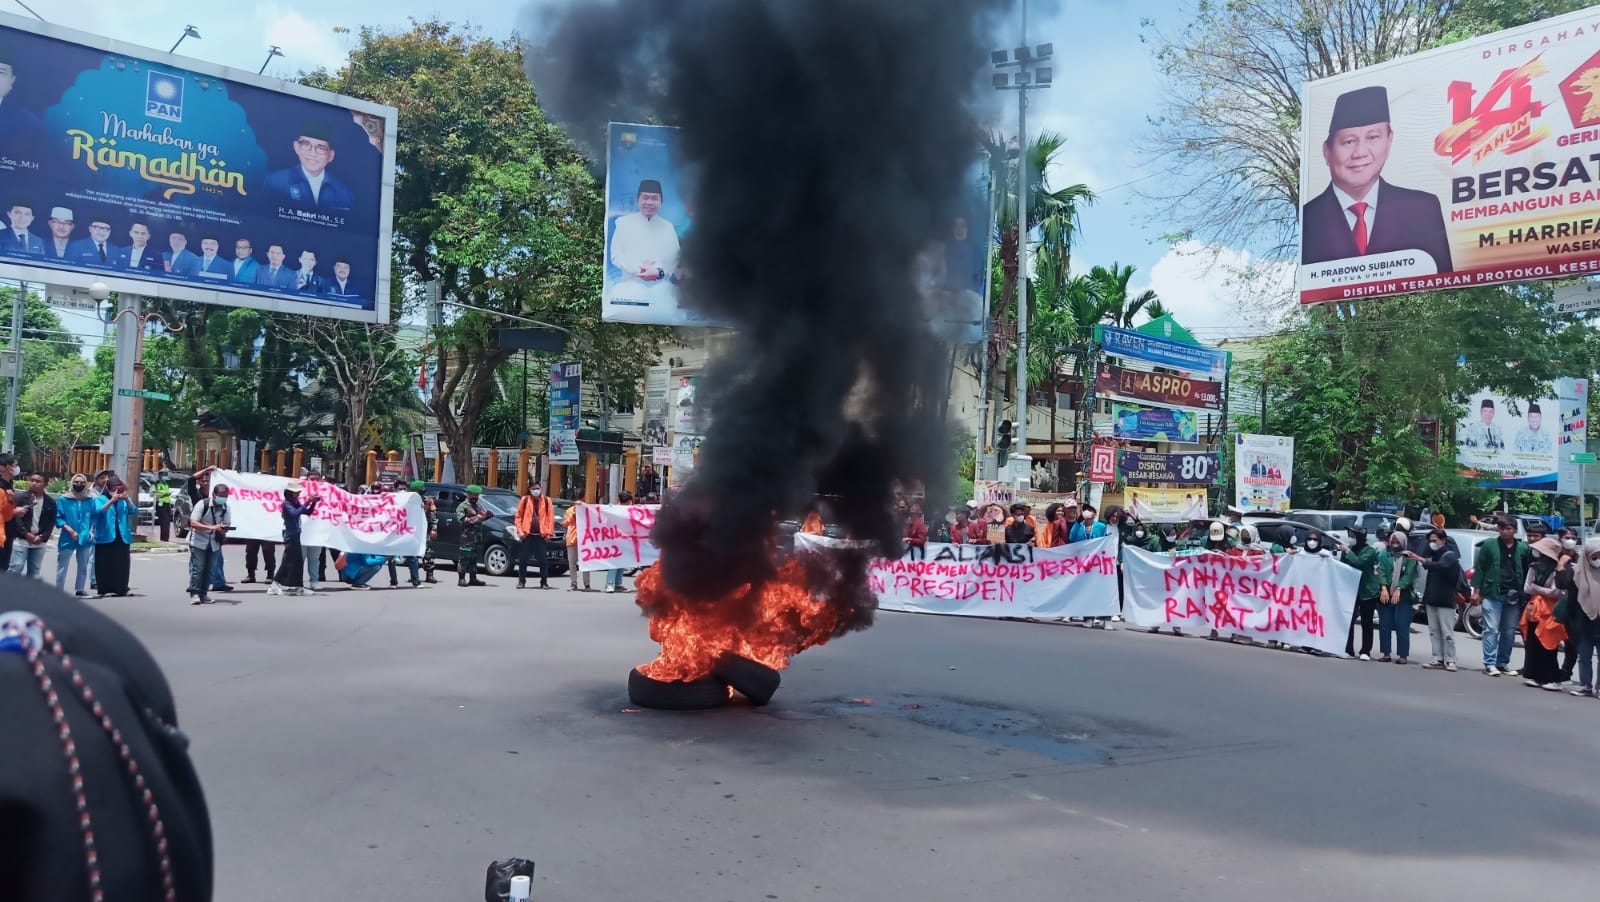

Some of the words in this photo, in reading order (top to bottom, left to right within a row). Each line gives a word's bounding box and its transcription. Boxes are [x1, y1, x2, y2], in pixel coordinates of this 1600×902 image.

[147, 102, 182, 118] PAN
[1446, 63, 1546, 165] 14
[100, 110, 194, 152] Marhaban
[197, 142, 219, 160] ya
[1474, 116, 1529, 161] TAHUN
[1451, 194, 1563, 221] MEMBANGUN
[1570, 188, 1600, 204] BA
[1479, 233, 1500, 248] M.
[1321, 264, 1366, 278] PRABOWO
[1368, 257, 1416, 271] SUBIANTO
[1332, 275, 1362, 283] KETUA
[1365, 271, 1392, 279] UMUM
[1343, 283, 1396, 297] DISIPLIN
[1401, 275, 1471, 290] TERAPKAN
[1477, 265, 1553, 282] PROTOKOL
[1559, 259, 1600, 273] KESE
[1140, 374, 1191, 397] ASPRO
[1138, 462, 1167, 471] DISKON
[582, 525, 624, 545] APRIL
[581, 545, 623, 562] 2022
[1164, 566, 1316, 609] MAHASISWA
